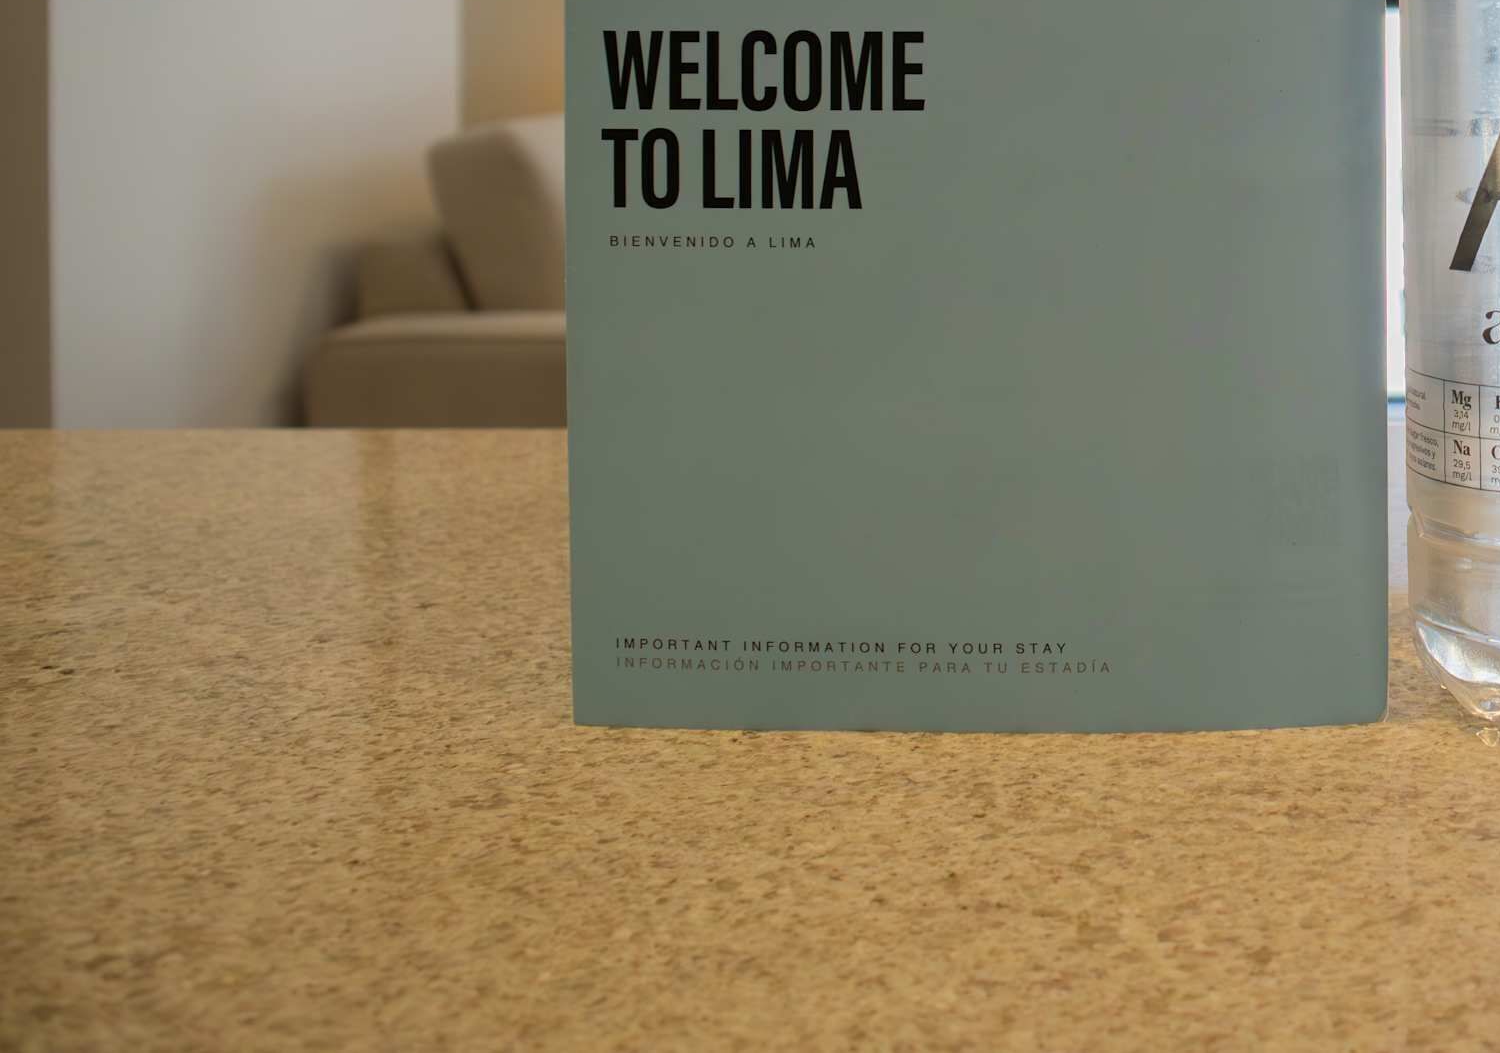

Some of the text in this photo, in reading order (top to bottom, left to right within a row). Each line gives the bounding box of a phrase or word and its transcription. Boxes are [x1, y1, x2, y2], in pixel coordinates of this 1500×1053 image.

[602, 29, 926, 112] WELCOME
[601, 127, 863, 210] TO LIMA
[609, 235, 816, 250] BIENVENIDO A LIMA
[1451, 388, 1472, 411] Mg
[1453, 409, 1470, 420] 3,14
[1451, 421, 1472, 432] mg/l
[1452, 439, 1472, 457] Na
[1453, 458, 1471, 471] 29,5
[1452, 471, 1473, 482] mg/l
[616, 637, 1067, 655] IMPORTANT INFORMATION FOR YOUR STAY
[616, 656, 1111, 674] INFORMACIÓN IMPORTANTE PARA TU ESTADÍA
